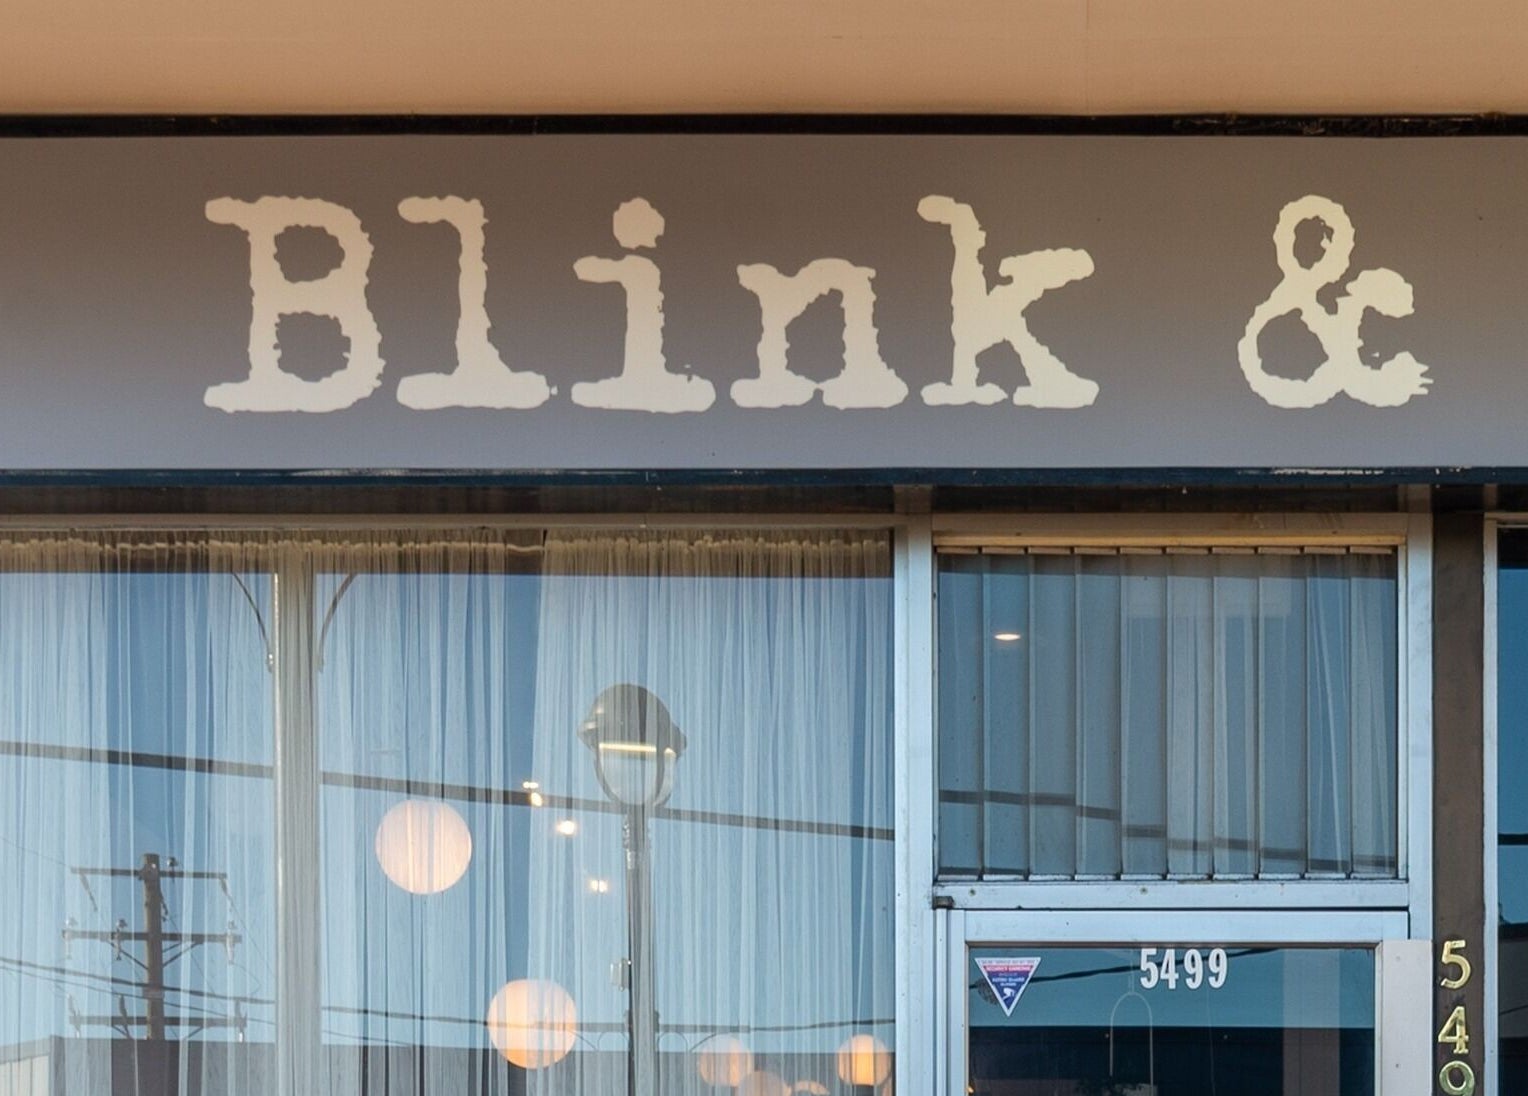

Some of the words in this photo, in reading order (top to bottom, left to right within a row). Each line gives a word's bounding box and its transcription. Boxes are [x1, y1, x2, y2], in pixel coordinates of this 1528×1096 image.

[203, 194, 1100, 414] Blink
[1237, 195, 1434, 408] &
[1140, 947, 1228, 990] 5499
